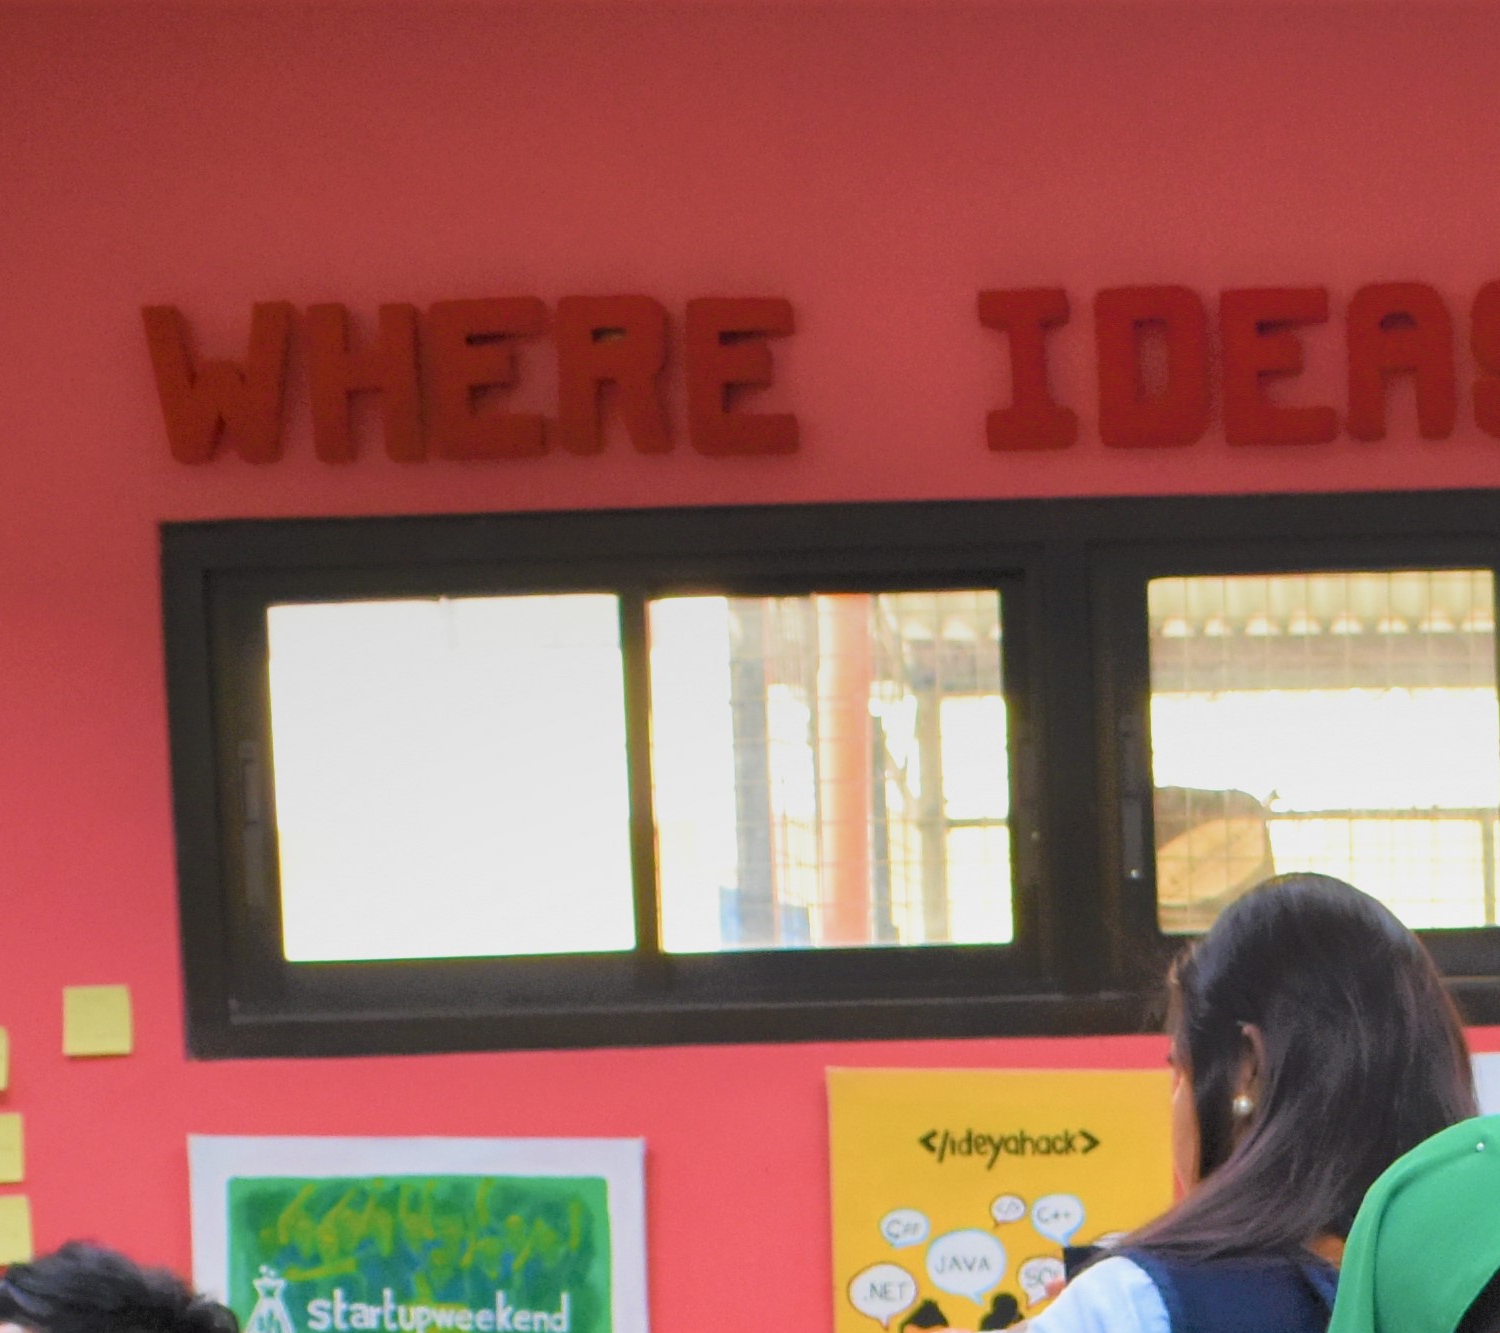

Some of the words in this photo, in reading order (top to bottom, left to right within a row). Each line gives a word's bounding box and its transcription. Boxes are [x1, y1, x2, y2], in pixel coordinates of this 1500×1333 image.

[144, 296, 798, 465] WHERE
[935, 1257, 991, 1273] JAVA
[863, 1280, 908, 1302] .NET
